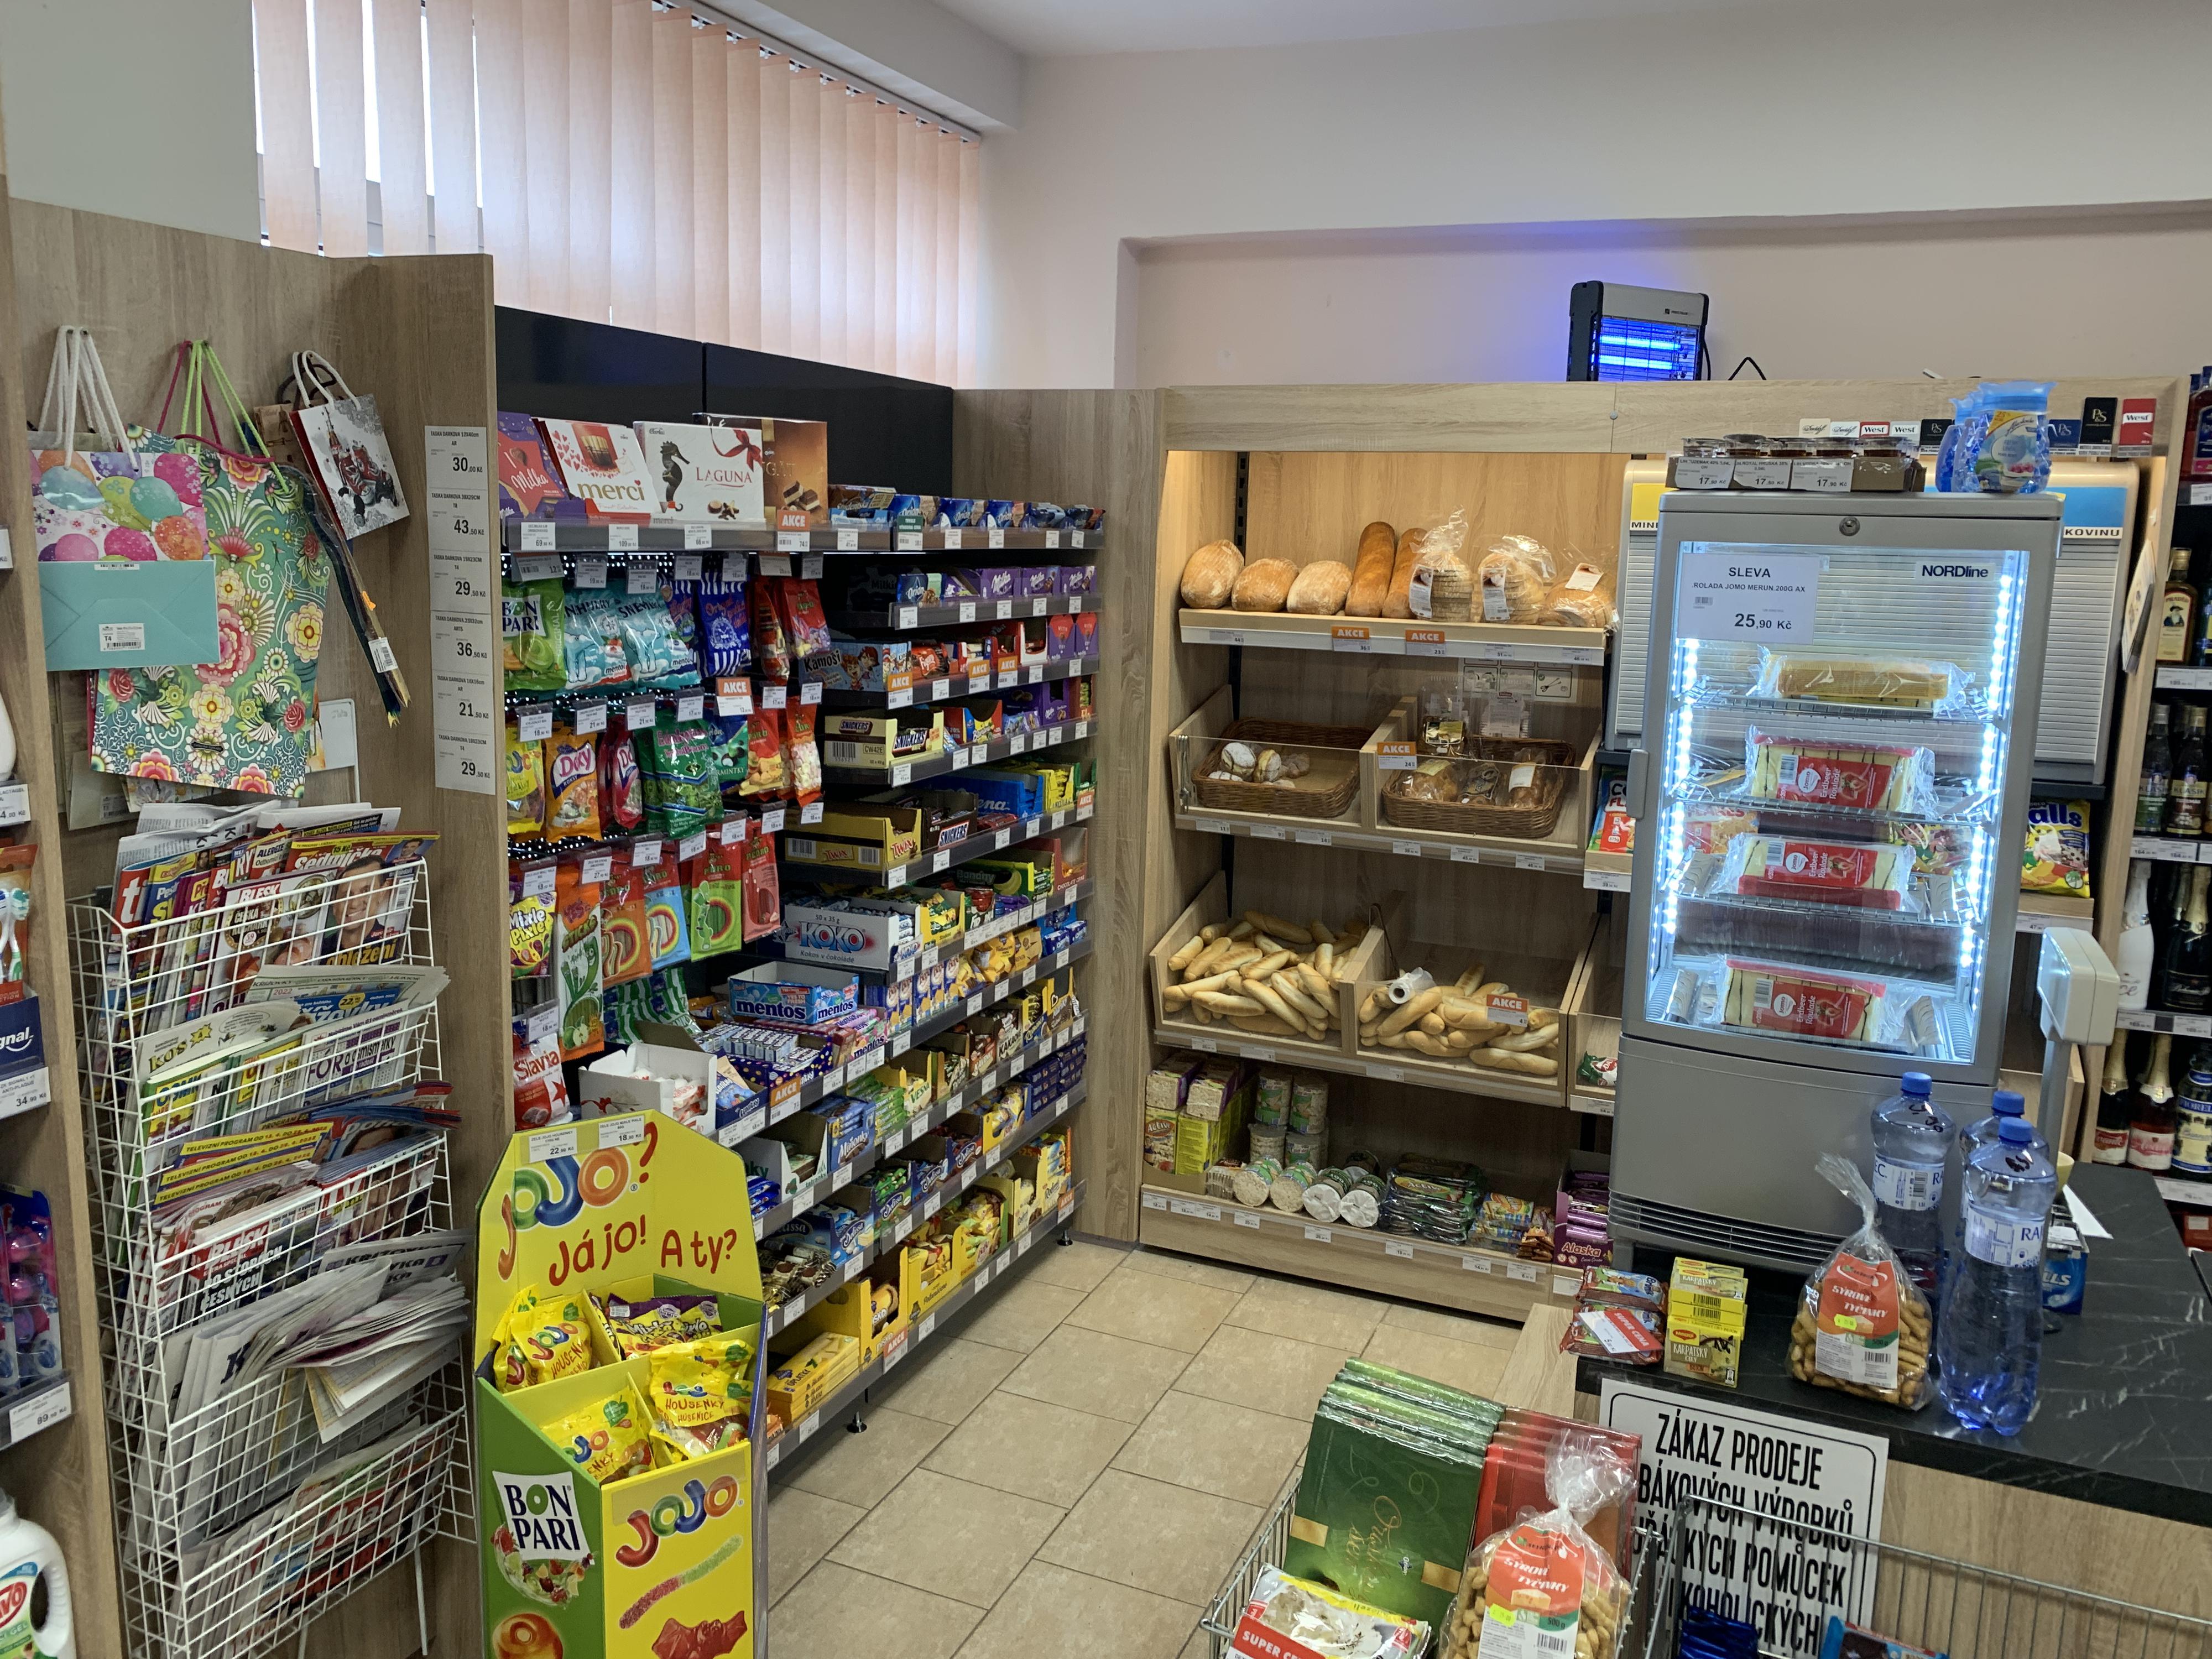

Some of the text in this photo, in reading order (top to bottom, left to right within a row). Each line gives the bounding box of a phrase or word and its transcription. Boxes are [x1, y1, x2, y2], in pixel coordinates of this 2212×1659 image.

[2126, 414, 2150, 422] West
[511, 468, 549, 493] Milka
[696, 467, 753, 484] LAGUNA
[577, 480, 645, 501] merci
[781, 514, 806, 528] AKCE
[1728, 567, 1771, 578] SLEVA
[1922, 565, 1989, 577] NORDline
[907, 586, 925, 599] Orion
[502, 601, 537, 616] BON
[502, 616, 539, 632] PARI
[1734, 613, 1792, 630] 25,90 Kč
[1337, 628, 1364, 638] AKCE
[1411, 633, 1440, 641] AKCE
[804, 649, 841, 672] Kamoši
[972, 663, 987, 675] AKCE
[1001, 659, 1016, 670] AKCE
[723, 681, 747, 693] AKCE
[891, 676, 910, 688] AKCE
[841, 721, 869, 731] SNICKERS
[894, 731, 927, 750] SNICKERS
[1383, 745, 1410, 753] AKCE
[1820, 768, 1832, 798] Erdbeer
[1829, 769, 1841, 800] Roulade
[2173, 786, 2206, 796] KLASIK
[940, 823, 968, 846] SNICKERS
[257, 843, 284, 857] ALERGIE
[825, 849, 848, 861] Twix
[891, 838, 916, 858] Twix
[1809, 851, 1819, 877] Erdbeer
[1818, 852, 1828, 878] Roulade
[509, 907, 546, 930] Mixle
[510, 921, 546, 946] Pixle
[800, 921, 865, 953] KOKO
[800, 950, 818, 959] Kokos
[736, 1000, 806, 1020] mentos
[817, 1001, 853, 1019] mentos
[1491, 997, 1524, 1010] AKCE
[1796, 993, 1807, 1022] Erdbeer
[1806, 995, 1816, 1025] Roulade
[148, 1040, 187, 1073] kos
[514, 1050, 560, 1080] Slavia
[775, 1082, 797, 1101] AKCE
[1147, 1121, 1172, 1133] Active
[186, 1141, 221, 1152] TELEVIZNÍ
[221, 1136, 253, 1146] PROGRAM
[166, 1167, 201, 1182] TELEVIZNÍ
[202, 1157, 236, 1171] PROGRAM
[159, 1187, 195, 1202] TELEVIZNÍ
[195, 1176, 230, 1190] PROGRAM
[549, 1215, 737, 1286] Já jo! A ty?
[1561, 1241, 1601, 1258] Alaska
[1614, 1312, 1649, 1347] SUPER CENA
[886, 1331, 906, 1354] AKCE
[665, 1397, 726, 1410] HOUSENKY
[677, 1411, 714, 1422] HUSENICE
[1656, 1408, 1823, 1491] ZÁKAZ PRODEJE
[504, 1484, 572, 1517] BON
[615, 1475, 739, 1567] JOJO
[1754, 1486, 1854, 1553] VÝROBKŮ
[512, 1518, 581, 1551] PARI
[1517, 1575, 1570, 1593] TYČINKY
[1743, 1542, 1847, 1608] POMŮCEK
[11, 1623, 28, 1636] GEL
[1548, 1617, 1560, 1628] 500
[1241, 1630, 1281, 1654] SUPER
